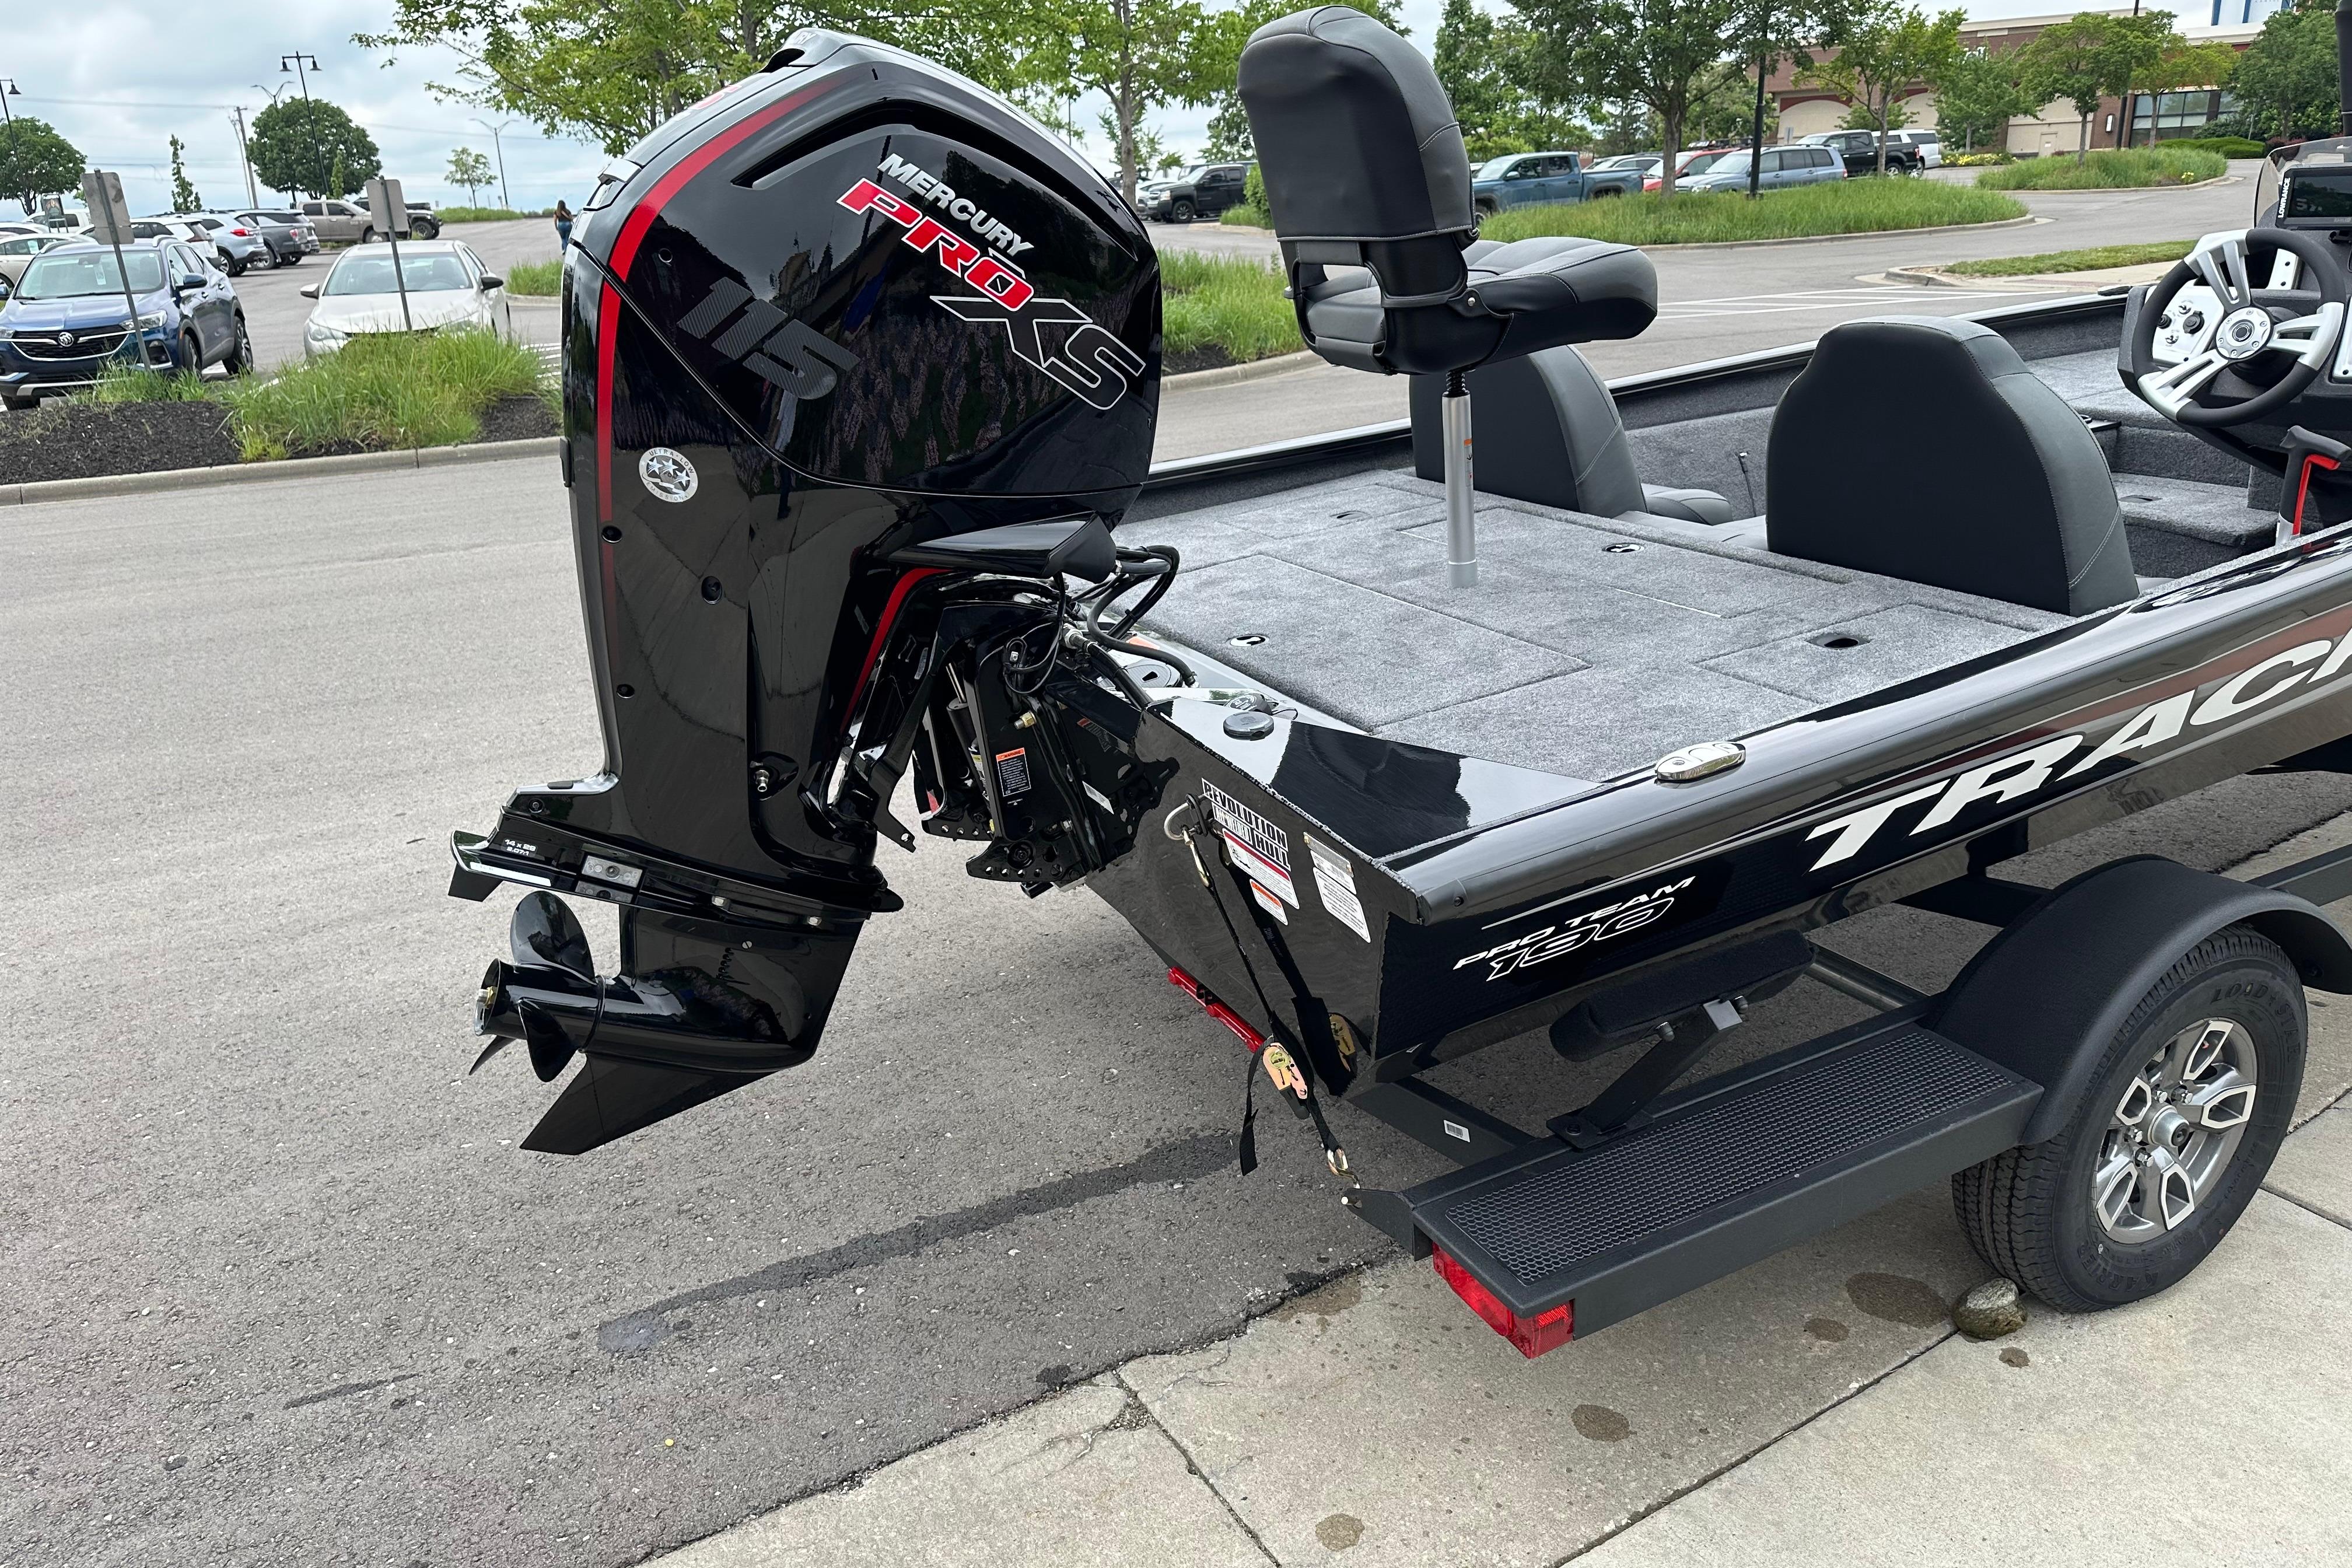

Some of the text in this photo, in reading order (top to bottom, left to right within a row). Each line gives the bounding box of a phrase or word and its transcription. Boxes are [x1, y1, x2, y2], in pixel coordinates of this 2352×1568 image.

[877, 153, 1034, 257] MERCURY
[2277, 177, 2291, 219] LOWRANCE
[678, 276, 861, 400] 115
[836, 178, 1146, 410] PRO XS
[1203, 781, 1287, 849] REVOLUTION
[1255, 832, 1290, 869] HULL
[1452, 876, 1696, 970] PRO TEAM
[1486, 897, 1674, 982] 190
